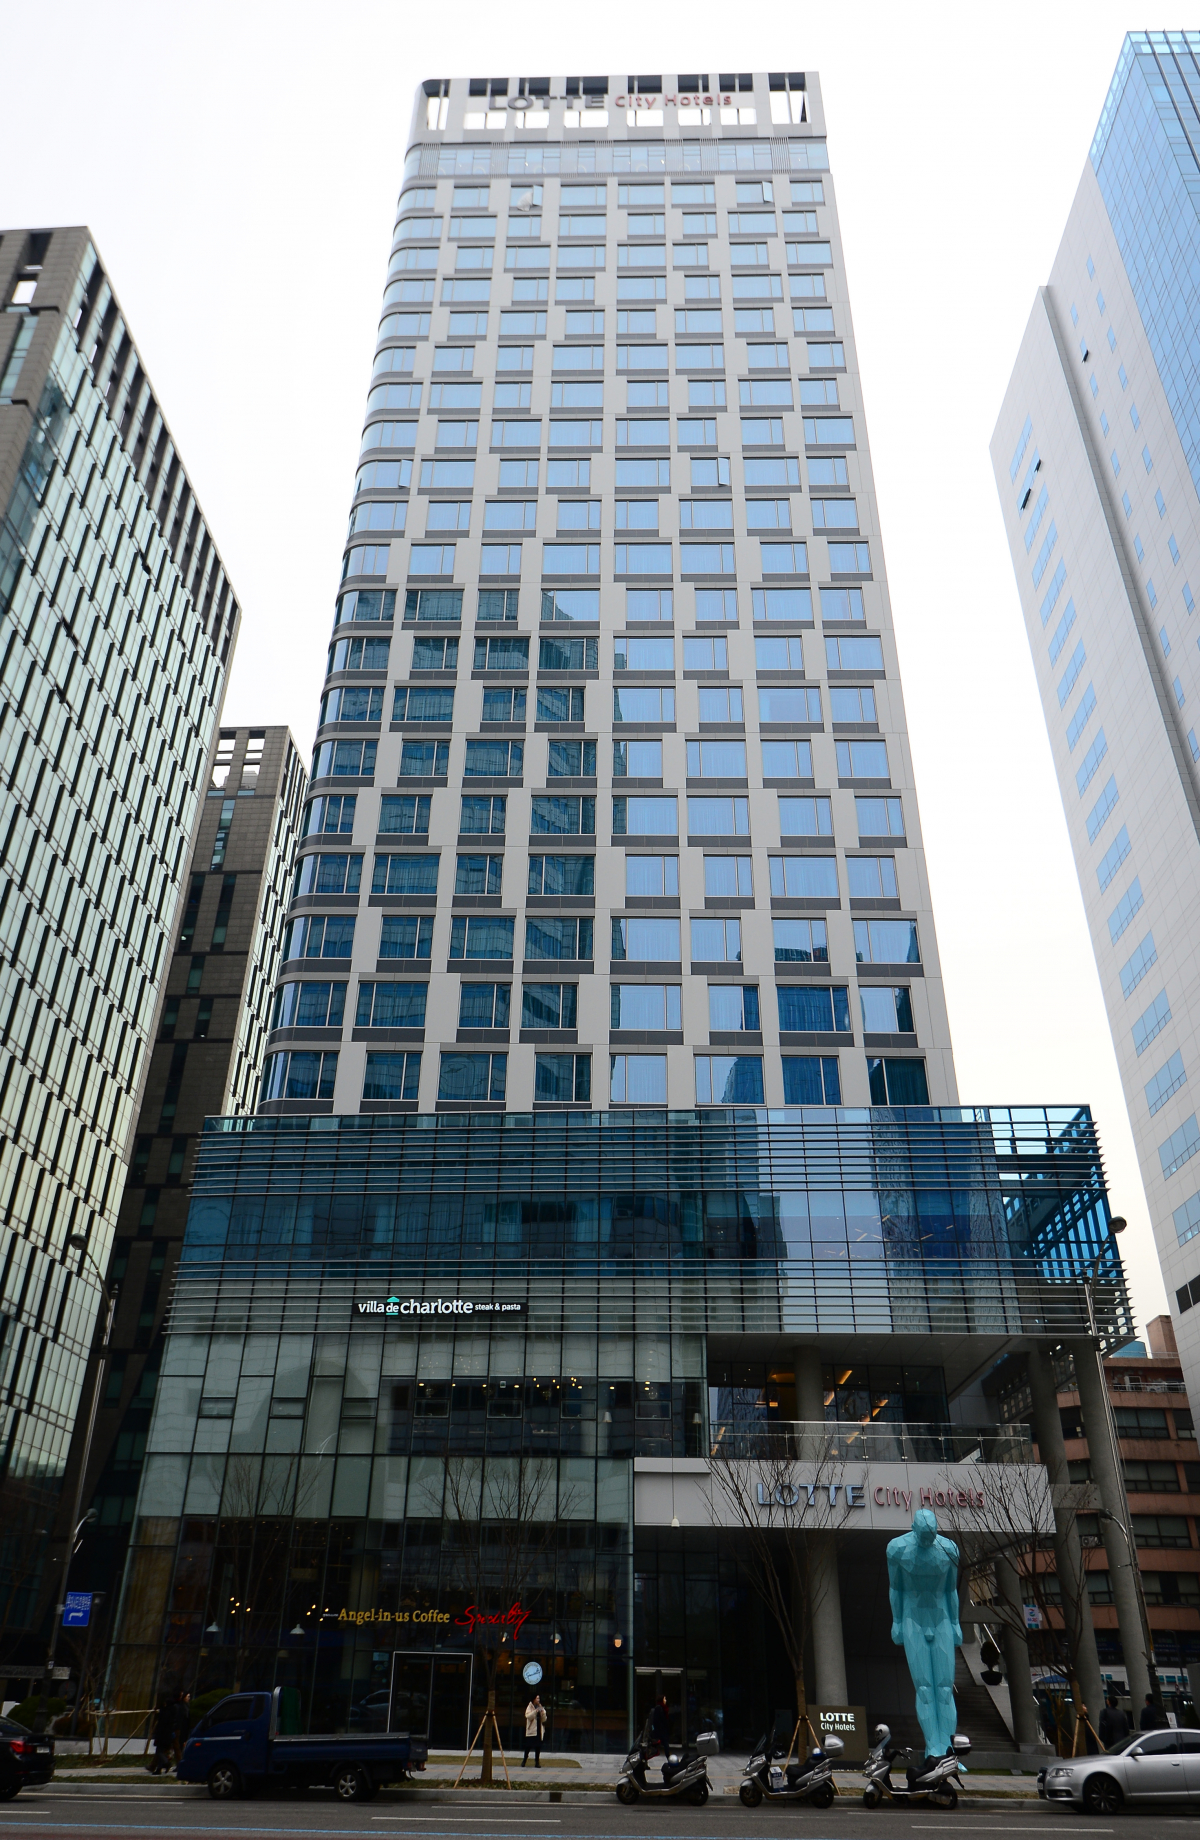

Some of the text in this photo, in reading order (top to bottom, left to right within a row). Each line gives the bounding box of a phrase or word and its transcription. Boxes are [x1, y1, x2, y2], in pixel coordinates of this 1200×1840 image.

[488, 93, 732, 111] LOTTE City Hotels
[358, 1299, 521, 1314] villa de charlotte steak & pasta
[756, 1482, 985, 1511] LOTTE City Hotels
[337, 1608, 410, 1625] Angel-in-us
[412, 1609, 450, 1623] Coffee
[820, 1712, 855, 1722] LOTTE
[820, 1722, 856, 1731] City Hotels
